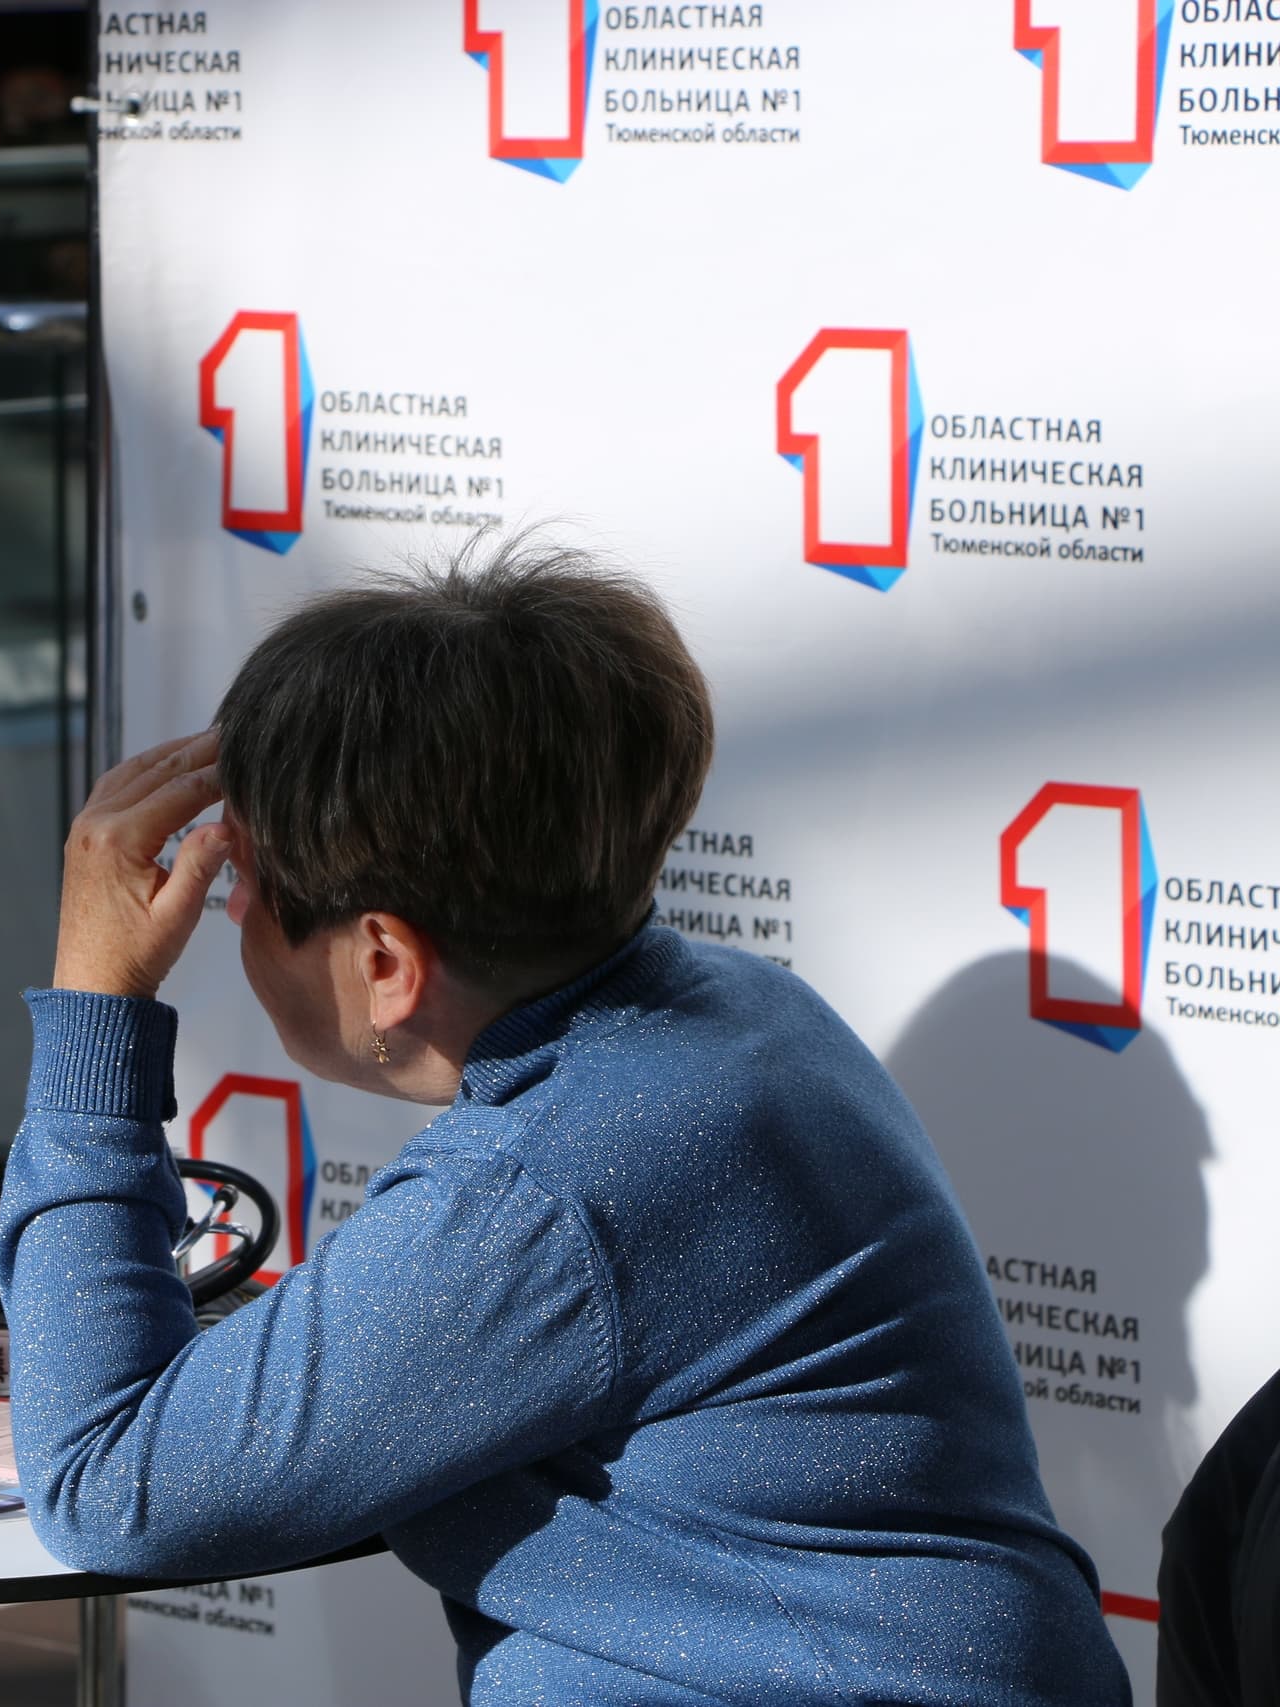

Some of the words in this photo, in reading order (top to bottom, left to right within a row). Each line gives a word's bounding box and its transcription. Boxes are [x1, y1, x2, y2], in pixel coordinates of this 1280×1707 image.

[605, 5, 762, 30] ОБЛАСТНАЯ
[605, 47, 800, 71] КЛИНИЧЕСКАЯ
[206, 90, 242, 112] №1
[605, 89, 750, 116] БОЛЬНИЦА
[762, 90, 801, 112] №1
[170, 120, 241, 140] области
[606, 122, 715, 144] Тюменской
[723, 122, 800, 144] области
[320, 390, 468, 418] ОБЛАСТНАЯ
[931, 414, 1101, 444] ОБЛАСТНАЯ
[321, 430, 502, 459] КЛИНИЧЕСКАЯ
[321, 468, 456, 499] БОЛЬНИЦА
[468, 475, 503, 499] №1
[930, 457, 1143, 489] КЛИНИЧЕСКАЯ
[324, 501, 423, 524] Тюменской
[431, 505, 503, 528] области
[930, 499, 1089, 533] БОЛЬНИЦА
[1102, 506, 1144, 531] №1
[932, 532, 1051, 559] Тюменской
[1058, 537, 1143, 563] области
[754, 917, 792, 942] №1
[1097, 1354, 1140, 1384] №1
[1055, 1382, 1141, 1414] области
